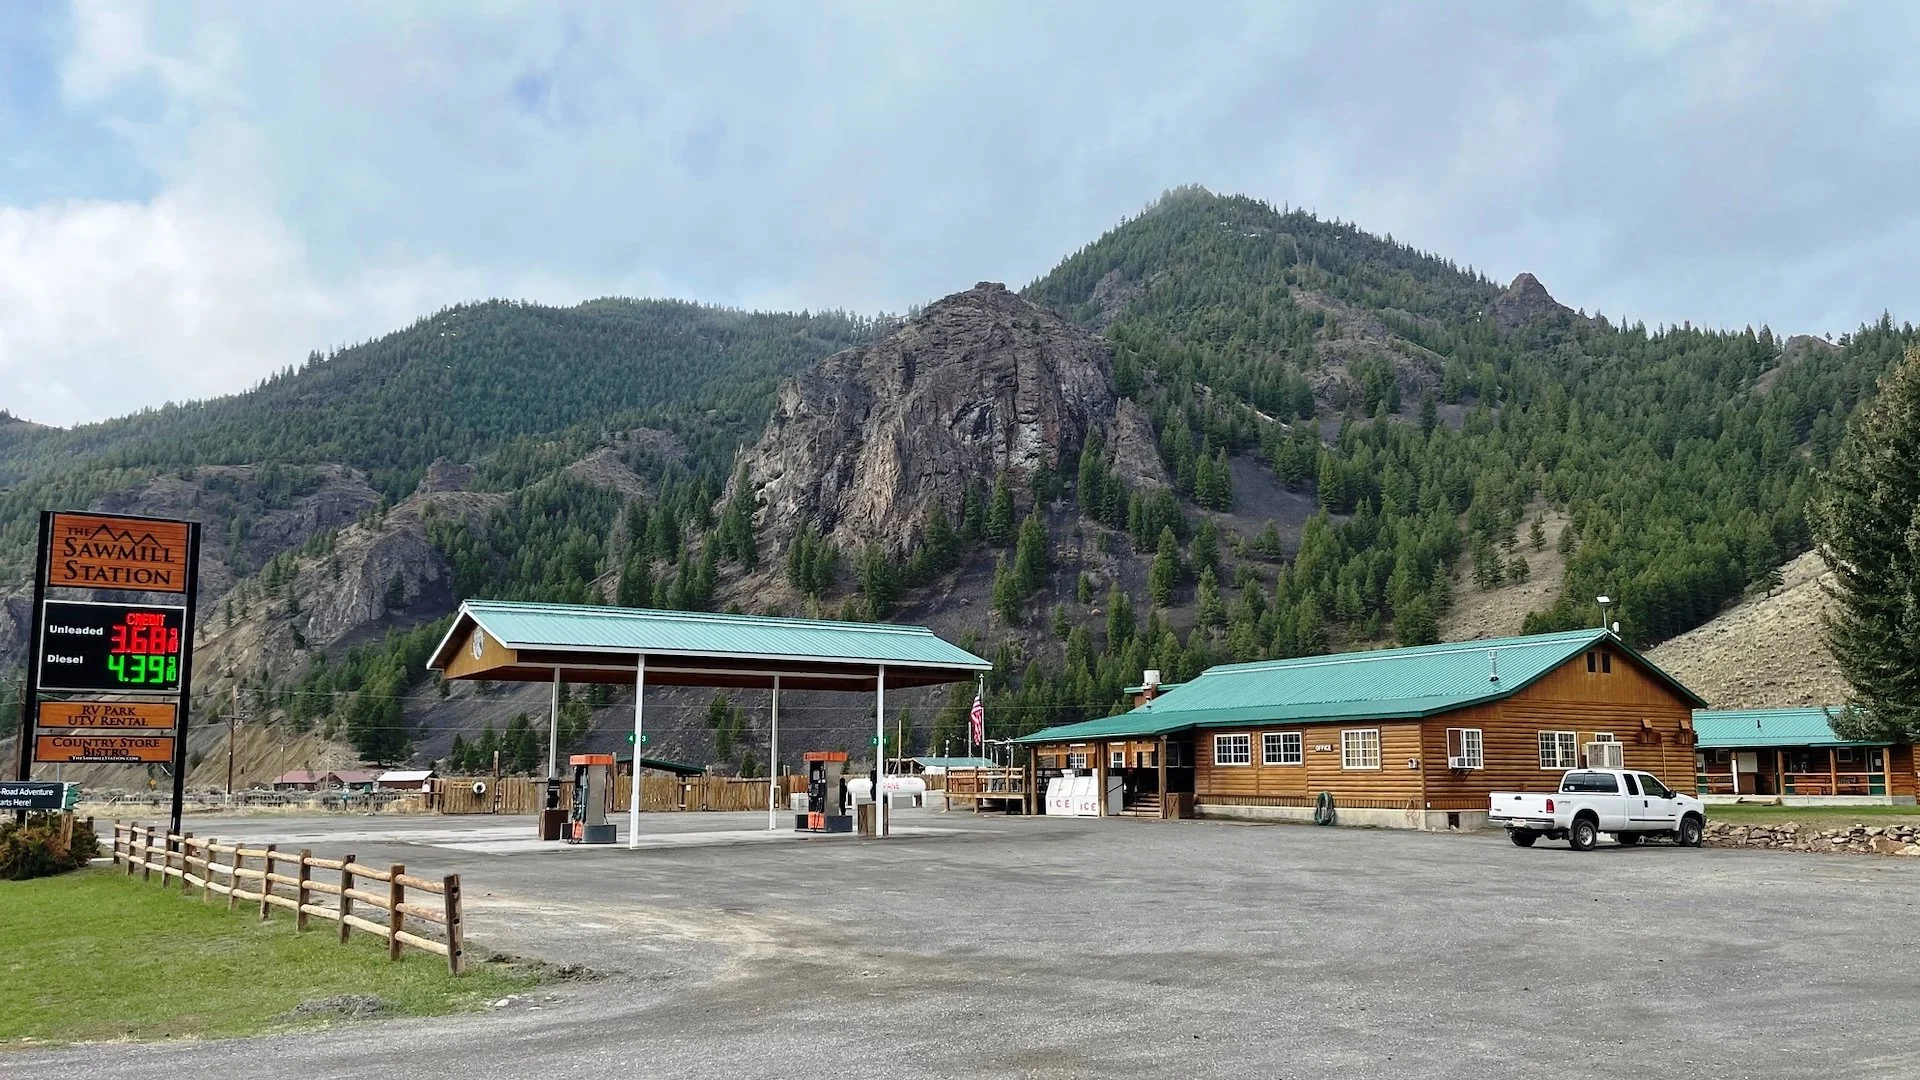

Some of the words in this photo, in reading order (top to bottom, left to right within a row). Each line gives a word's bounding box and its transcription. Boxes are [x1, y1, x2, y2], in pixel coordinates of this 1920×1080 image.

[66, 526, 91, 537] THE
[65, 537, 174, 562] SAWMILL
[64, 560, 171, 585] STATION
[126, 613, 166, 627] CREDIT
[49, 625, 103, 636] Unleaded
[47, 655, 83, 664] Diesel
[108, 654, 165, 683] 4.39
[81, 705, 102, 716] RV
[106, 706, 136, 716] PARK
[68, 716, 98, 726] UTV
[100, 716, 148, 727] RENTAL
[52, 737, 117, 748] COUNTRY
[119, 737, 160, 748] STORE
[83, 747, 129, 757] BISTRO
[19, 788, 54, 796] Adventure
[13, 799, 32, 807] Here!
[1049, 799, 1070, 809] ICE
[1080, 802, 1097, 812] ICE
